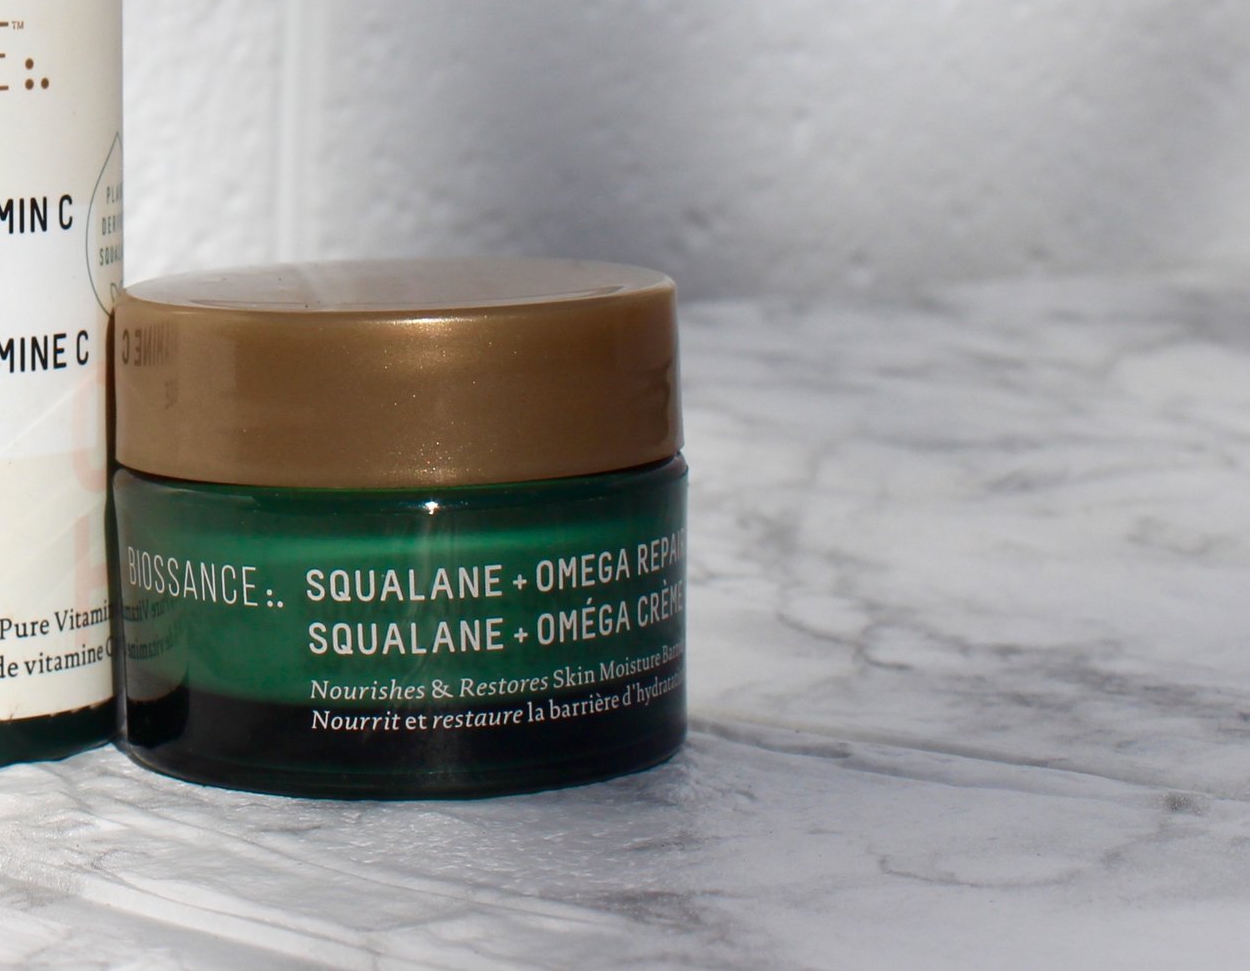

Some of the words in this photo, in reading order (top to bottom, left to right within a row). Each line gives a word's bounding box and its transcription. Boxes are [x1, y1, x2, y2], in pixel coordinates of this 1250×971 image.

[58, 194, 74, 230] C
[106, 184, 123, 204] PLA
[76, 330, 90, 365] C
[306, 564, 502, 603] SQUALANE
[513, 574, 528, 590] +
[536, 548, 630, 590] OMEGA
[308, 617, 504, 655] SQUALANE
[513, 627, 529, 643] +
[537, 596, 631, 646] OMÉGA
[637, 579, 685, 628] CRÈME
[24, 644, 104, 676] vitamine
[310, 679, 425, 700] Nourishes
[432, 679, 453, 699] &
[460, 676, 549, 698] Restores
[553, 666, 595, 689] Skin
[600, 652, 661, 682] Moisture
[312, 710, 401, 731] Nourrit
[405, 714, 427, 730] et
[432, 705, 523, 728] restaure
[527, 701, 545, 723] la
[549, 692, 620, 720] barrière
